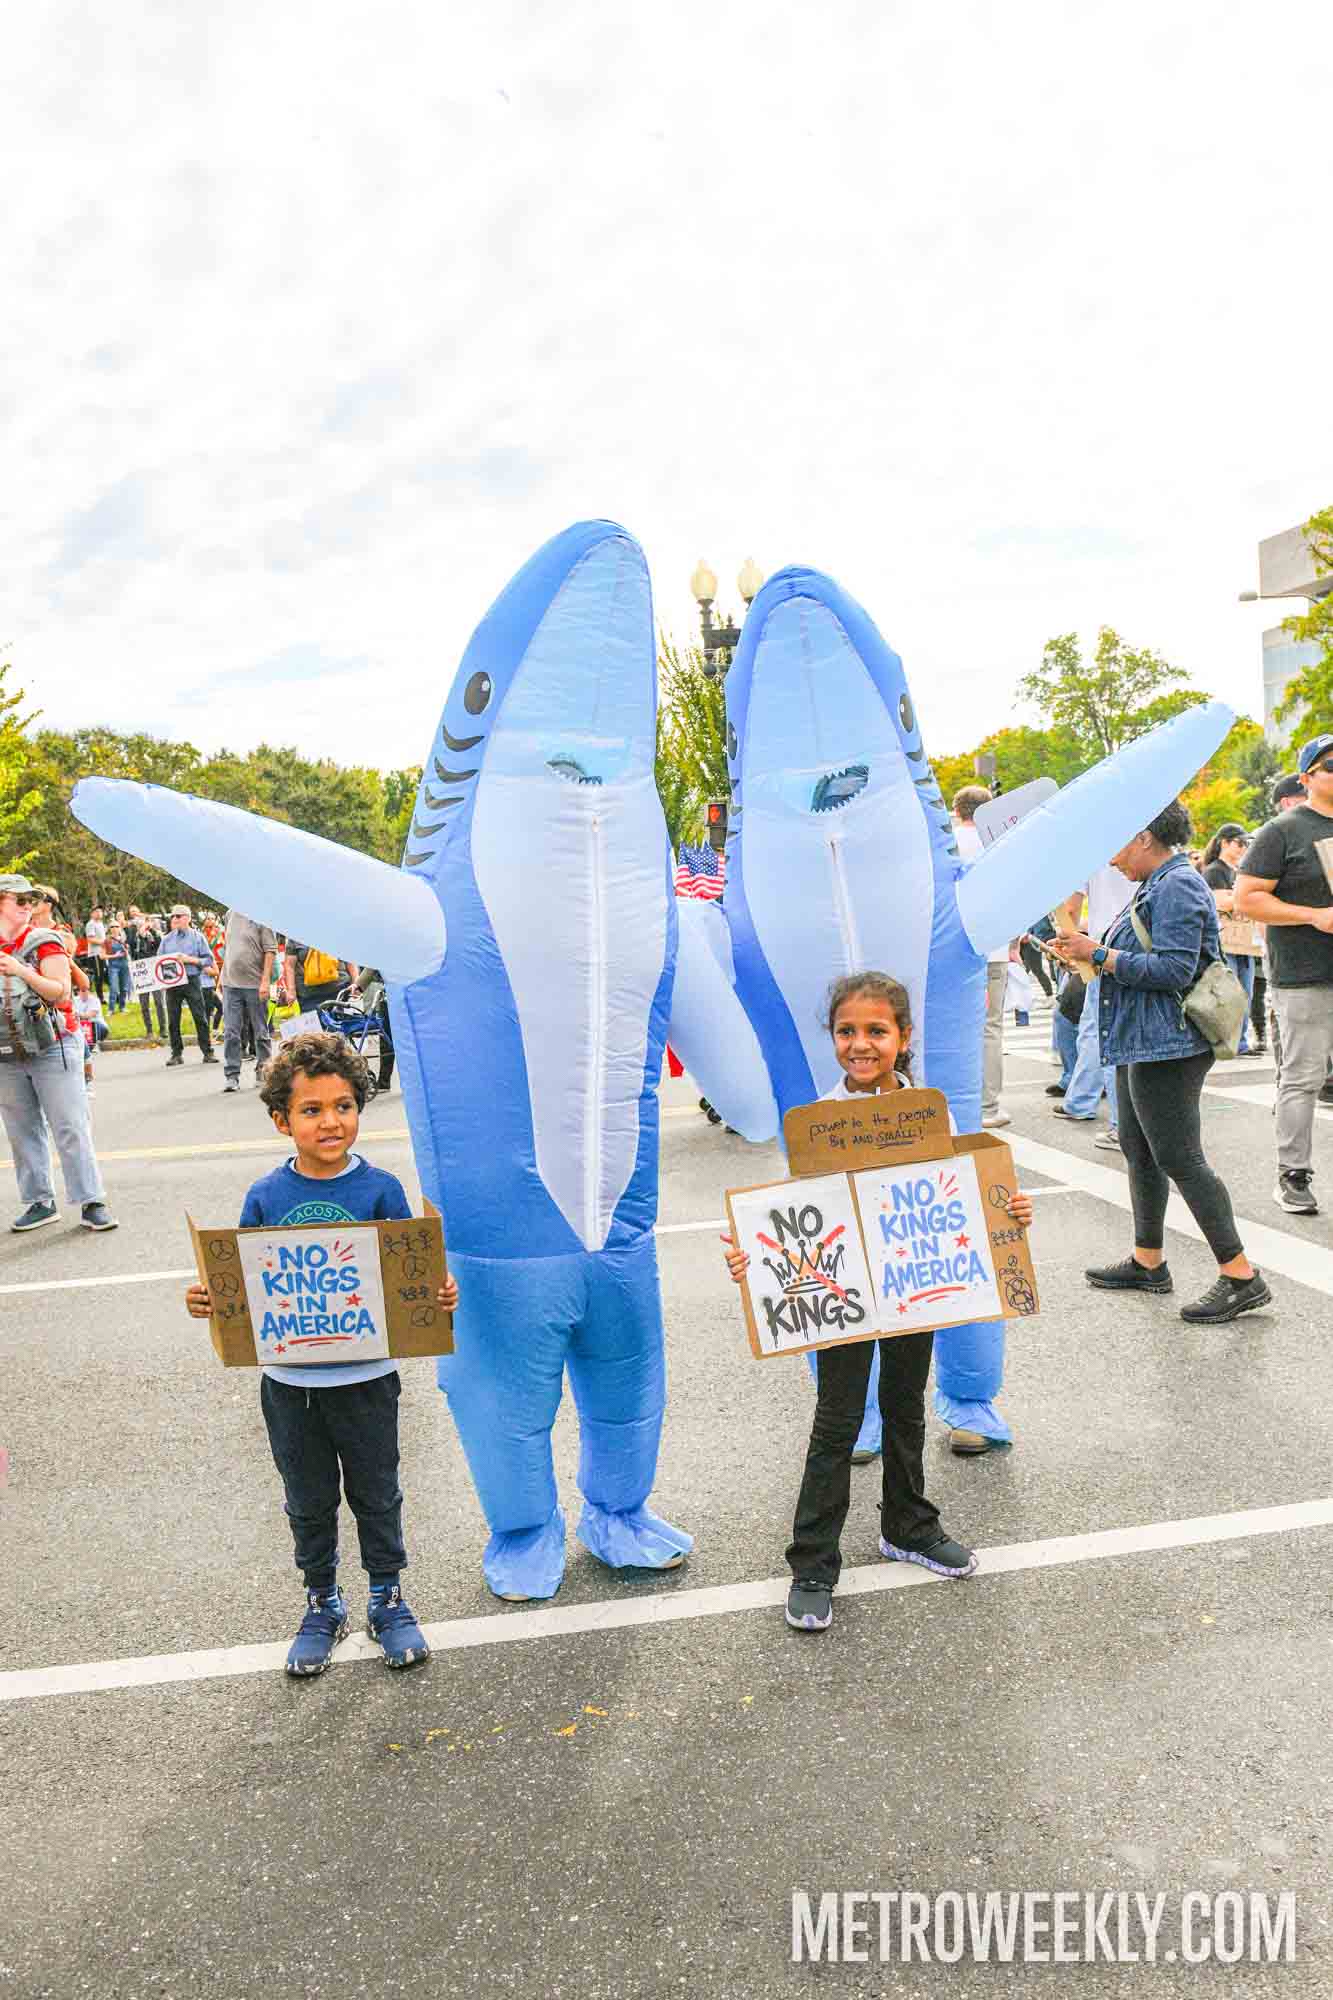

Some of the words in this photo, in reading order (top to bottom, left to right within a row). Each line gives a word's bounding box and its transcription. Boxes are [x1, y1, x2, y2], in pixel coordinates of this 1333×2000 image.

[872, 1112, 889, 1127] the
[897, 1105, 936, 1129] people
[852, 1134, 873, 1145] AND
[890, 1179, 934, 1210] NO
[770, 1205, 823, 1243] NO
[879, 1200, 967, 1244] KINGS
[279, 1244, 328, 1270] NO
[911, 1236, 940, 1261] IN
[262, 1266, 361, 1296] KINGS
[882, 1252, 987, 1295] AMERICA
[296, 1294, 326, 1313] IN
[260, 1308, 376, 1340] AMERICA
